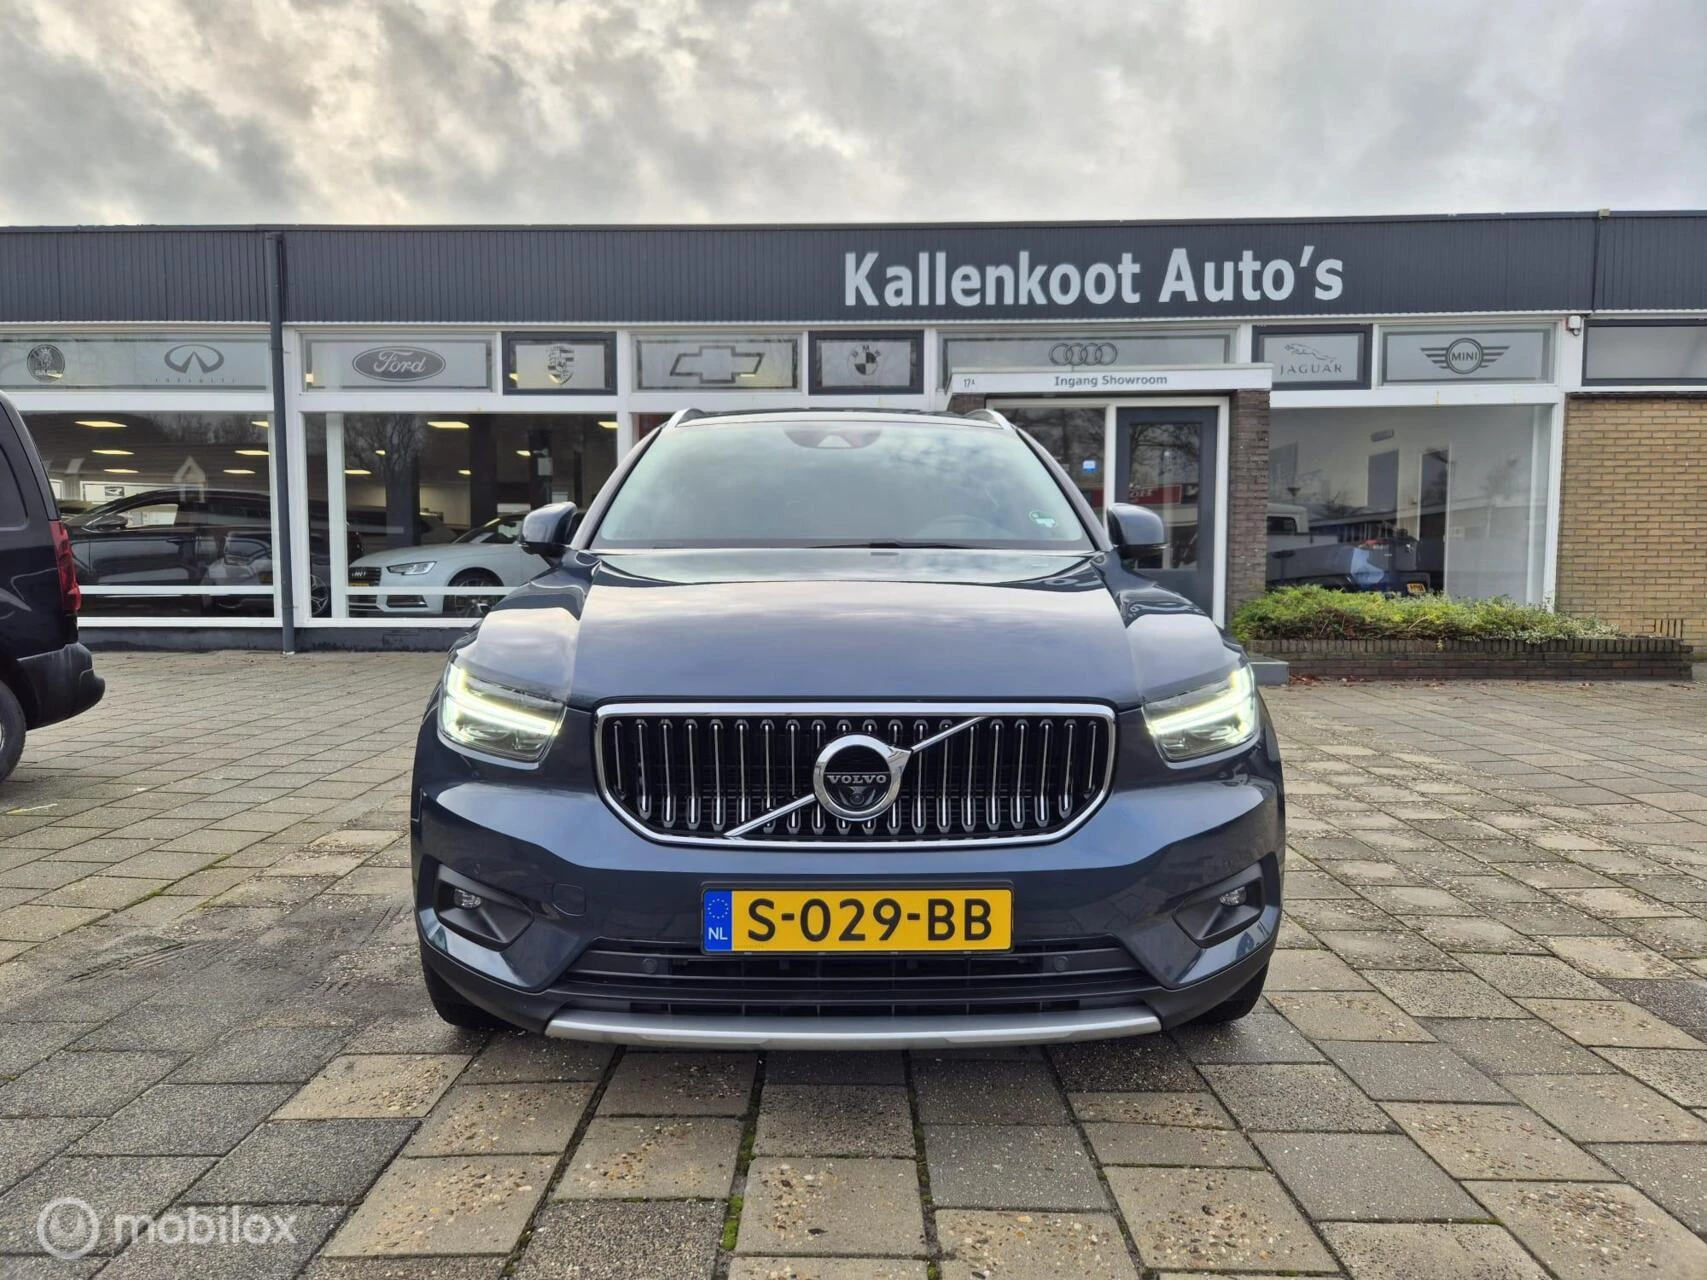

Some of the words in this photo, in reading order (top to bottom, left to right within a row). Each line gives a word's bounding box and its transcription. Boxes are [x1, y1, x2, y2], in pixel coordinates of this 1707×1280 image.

[844, 250, 1141, 307] Kallenkoot
[1158, 246, 1344, 303] Auto's
[373, 350, 427, 373] Ford
[1451, 351, 1478, 362] MINI
[1280, 363, 1343, 375] JAGUAR
[1054, 376, 1098, 388] Ingang
[1101, 375, 1168, 386] Showroom
[827, 774, 887, 784] VOLVO
[747, 897, 992, 942] S-029-BB
[708, 927, 728, 941] NL
